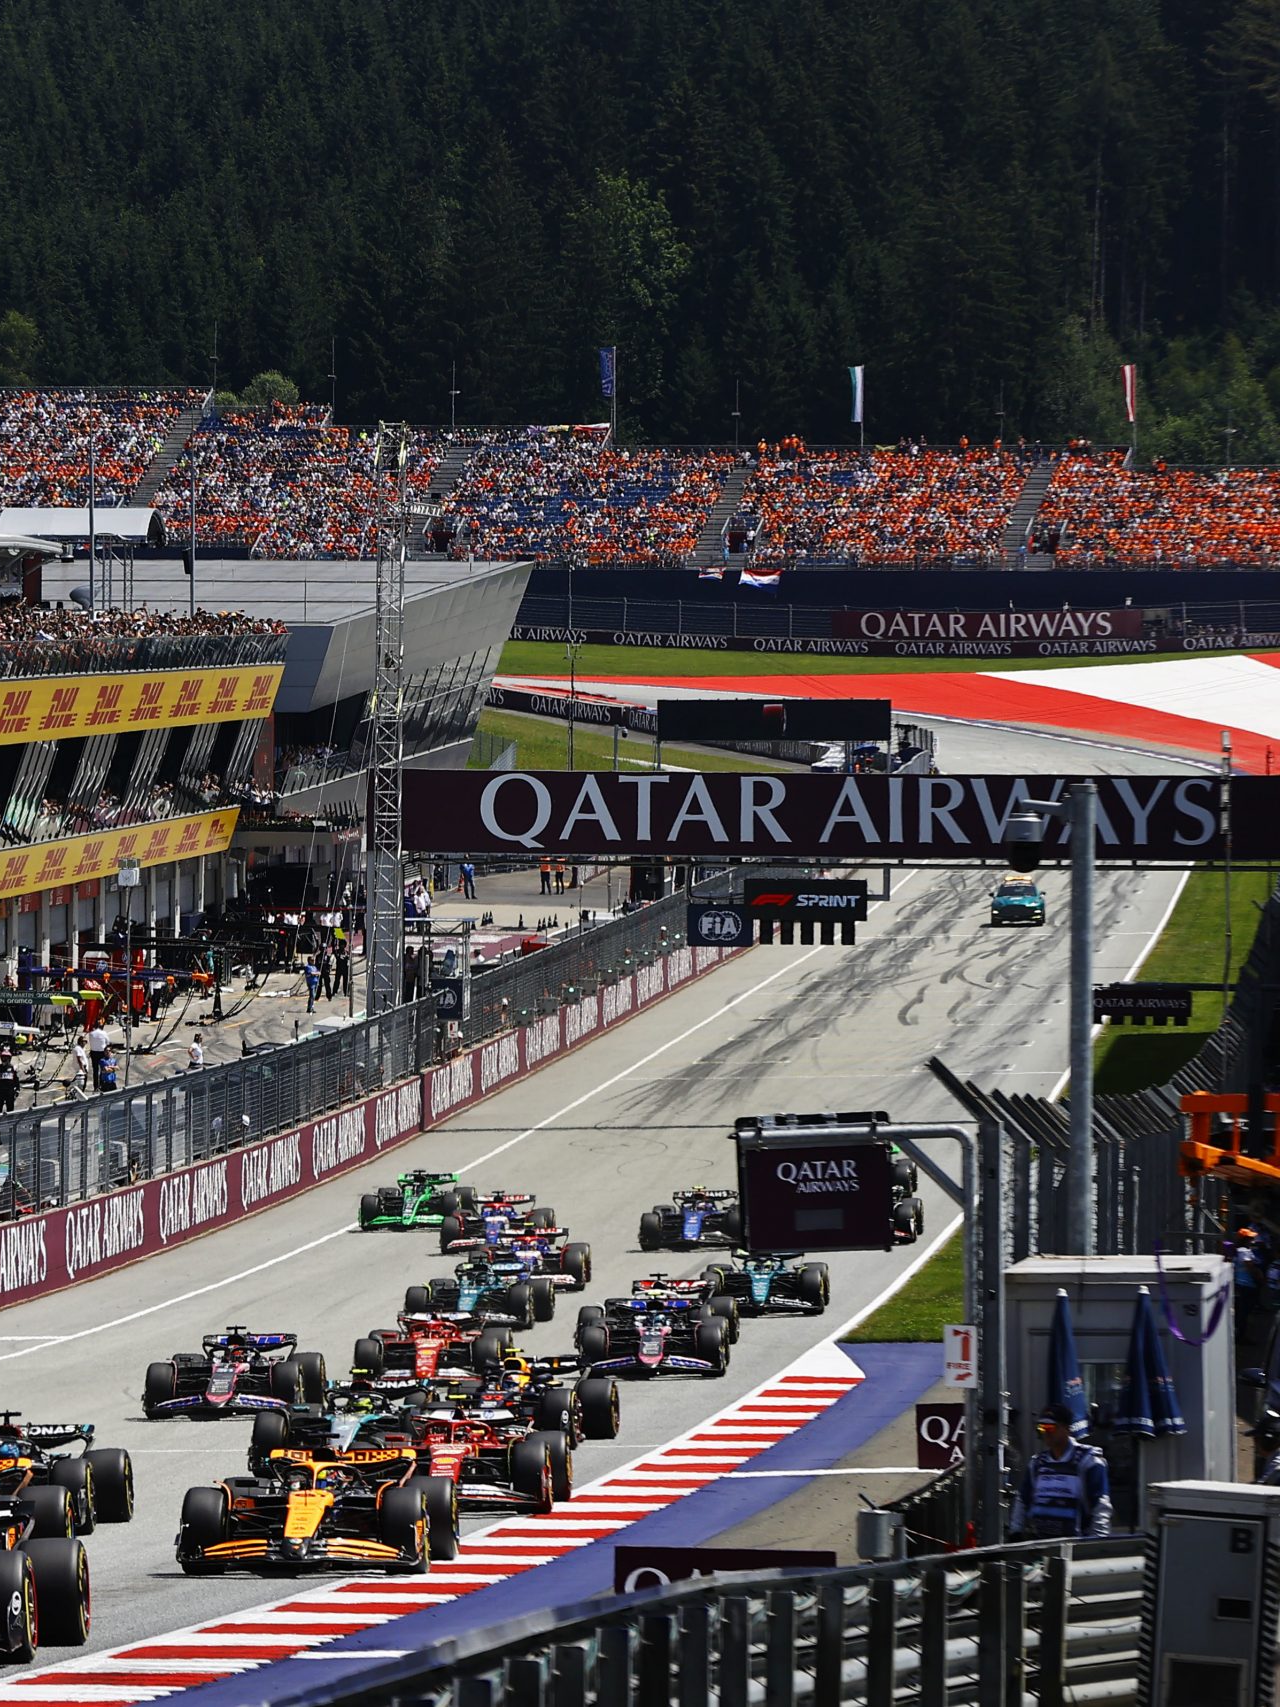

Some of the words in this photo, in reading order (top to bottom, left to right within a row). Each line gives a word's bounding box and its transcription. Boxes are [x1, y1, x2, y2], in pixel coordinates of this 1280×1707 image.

[526, 627, 587, 643] AIRWAYS
[860, 612, 967, 640] QATAR
[978, 612, 1112, 638] AIRWAYS
[613, 632, 662, 646] QATAR
[665, 634, 728, 649] AIRWAYS
[754, 638, 804, 653] QATAR
[806, 640, 869, 654] AIRWAYS
[895, 641, 947, 656] QATAR
[948, 641, 1012, 656] AIRWAYS
[1038, 641, 1090, 656] QATAR
[1093, 639, 1157, 654] AIRWAYS
[1183, 637, 1235, 651] QATAR
[38, 687, 80, 730] DHL
[85, 684, 124, 726] DHL
[128, 681, 165, 721] DHL
[170, 679, 203, 717] DHL
[206, 676, 239, 714] DHL
[242, 674, 274, 711] DHL
[531, 694, 567, 716] QATAR
[570, 701, 611, 723] IRWAYS
[628, 709, 654, 730] QATAR
[480, 773, 792, 848] QATAR
[35, 847, 69, 884] DHL
[796, 895, 862, 907] SPRINT
[1093, 998, 1134, 1008] QATAR
[1136, 998, 1187, 1009] AIRWAYS
[312, 1117, 337, 1180] QATAR
[337, 1104, 366, 1164] AIRWAYS
[241, 1148, 268, 1211] QATAR
[269, 1132, 301, 1195] AIRWAYS
[777, 1160, 857, 1184] QATAR
[797, 1180, 860, 1193] AIRWAYS
[159, 1173, 190, 1245] QATAR
[191, 1159, 228, 1225] AIRWAYS
[65, 1202, 101, 1279] QATAR
[102, 1188, 145, 1261] AIRWAYS
[0, 1219, 47, 1293] AIRWAYS
[947, 1362, 971, 1370] FIRE
[1230, 1528, 1253, 1552] B
